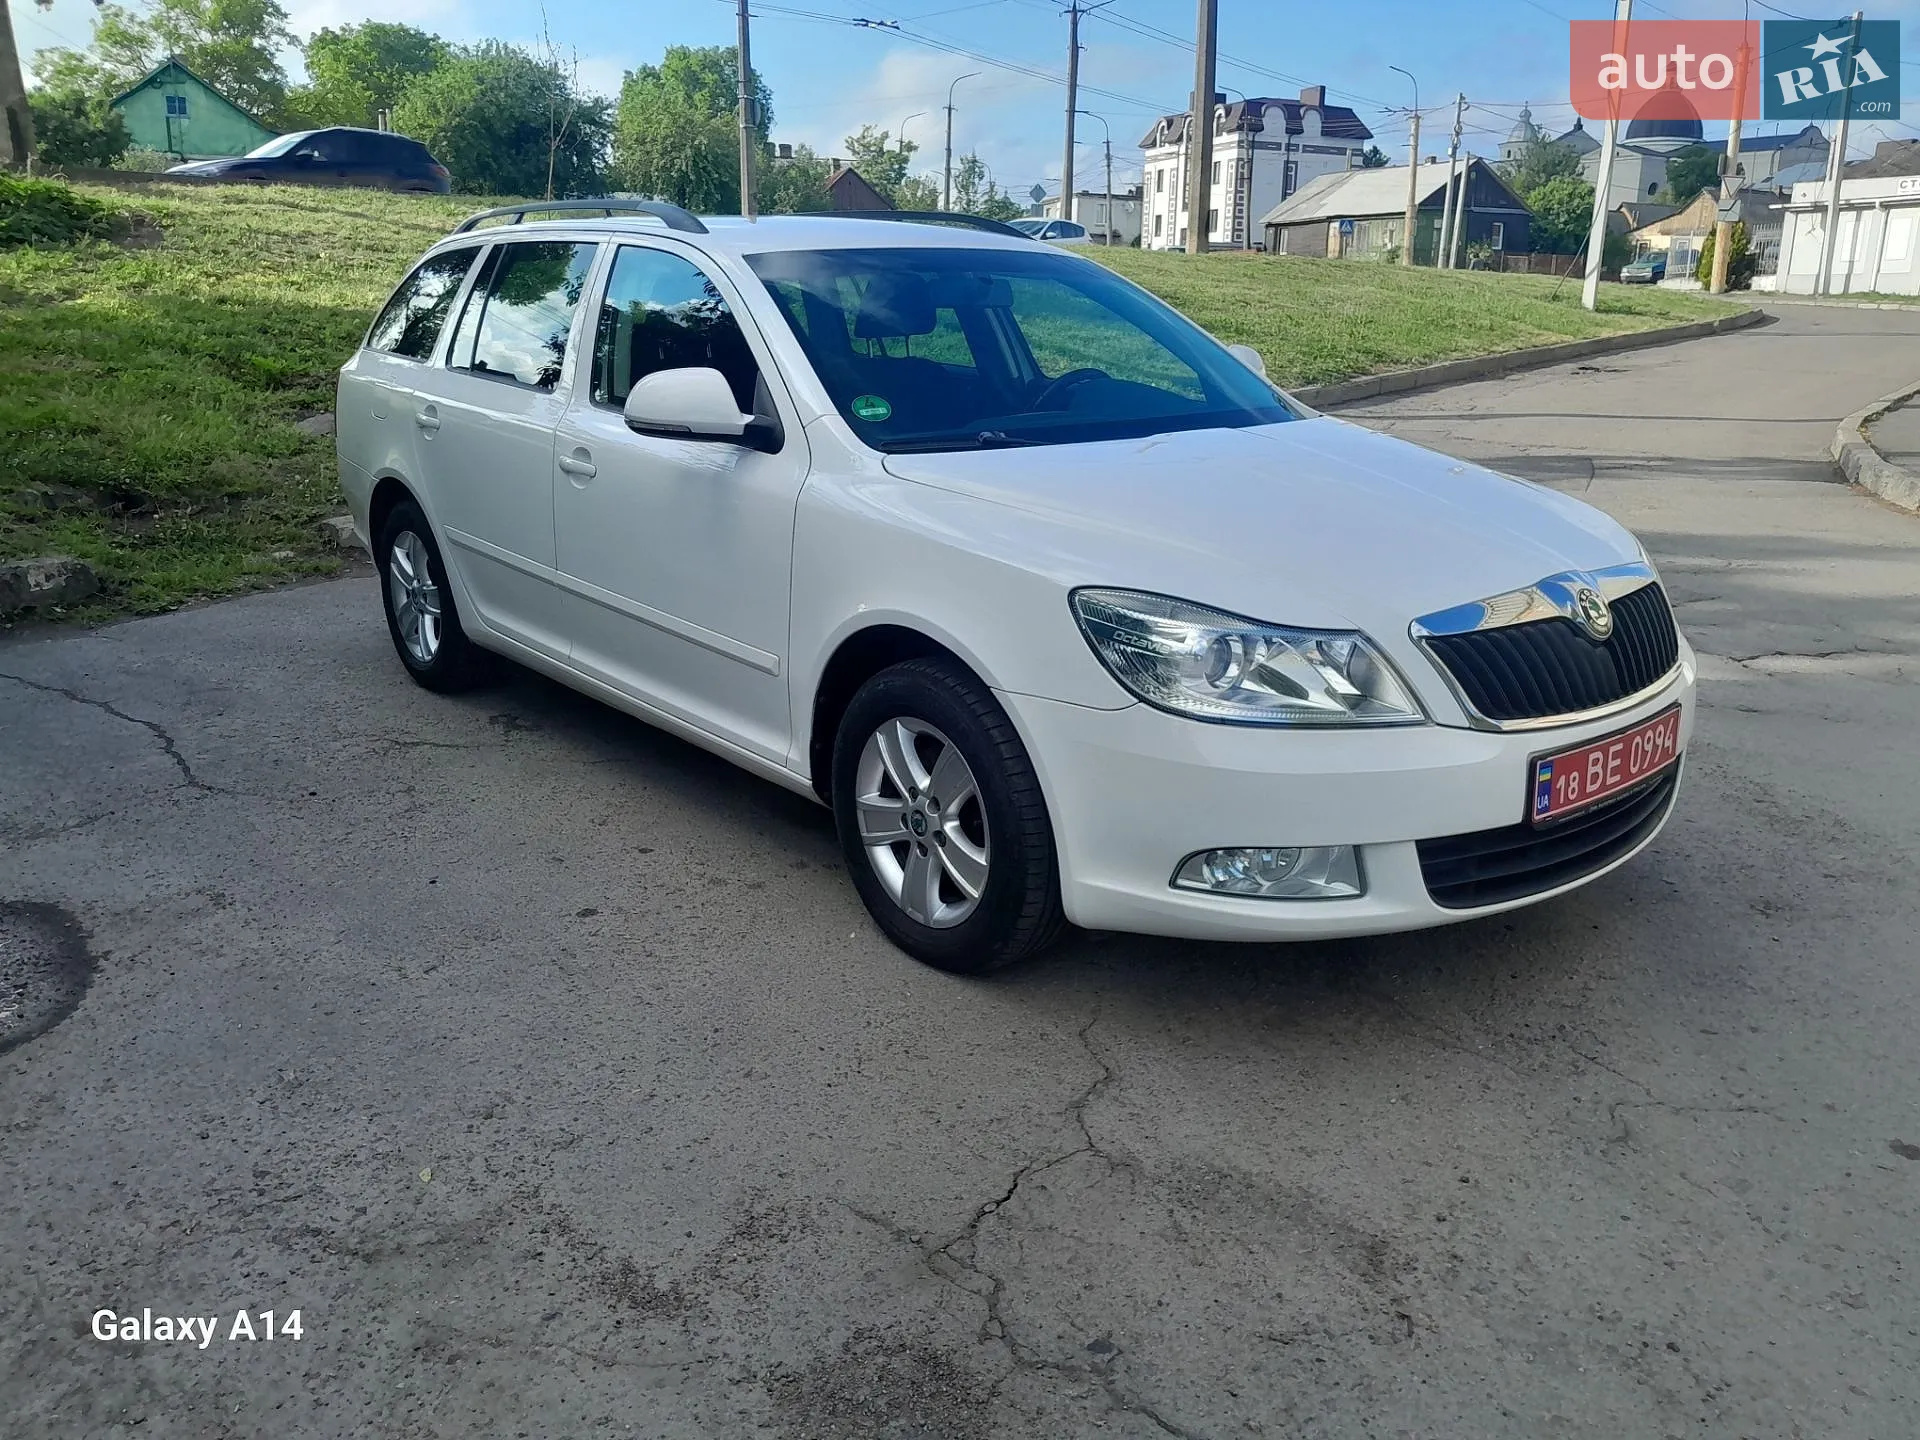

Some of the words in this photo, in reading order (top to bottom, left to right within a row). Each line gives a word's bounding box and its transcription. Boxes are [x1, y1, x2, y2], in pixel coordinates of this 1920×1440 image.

[1900, 179, 1920, 189] СТ
[1556, 771, 1580, 804] 18
[1586, 742, 1624, 794] BE
[1629, 717, 1675, 775] 0994
[1537, 795, 1549, 809] UA
